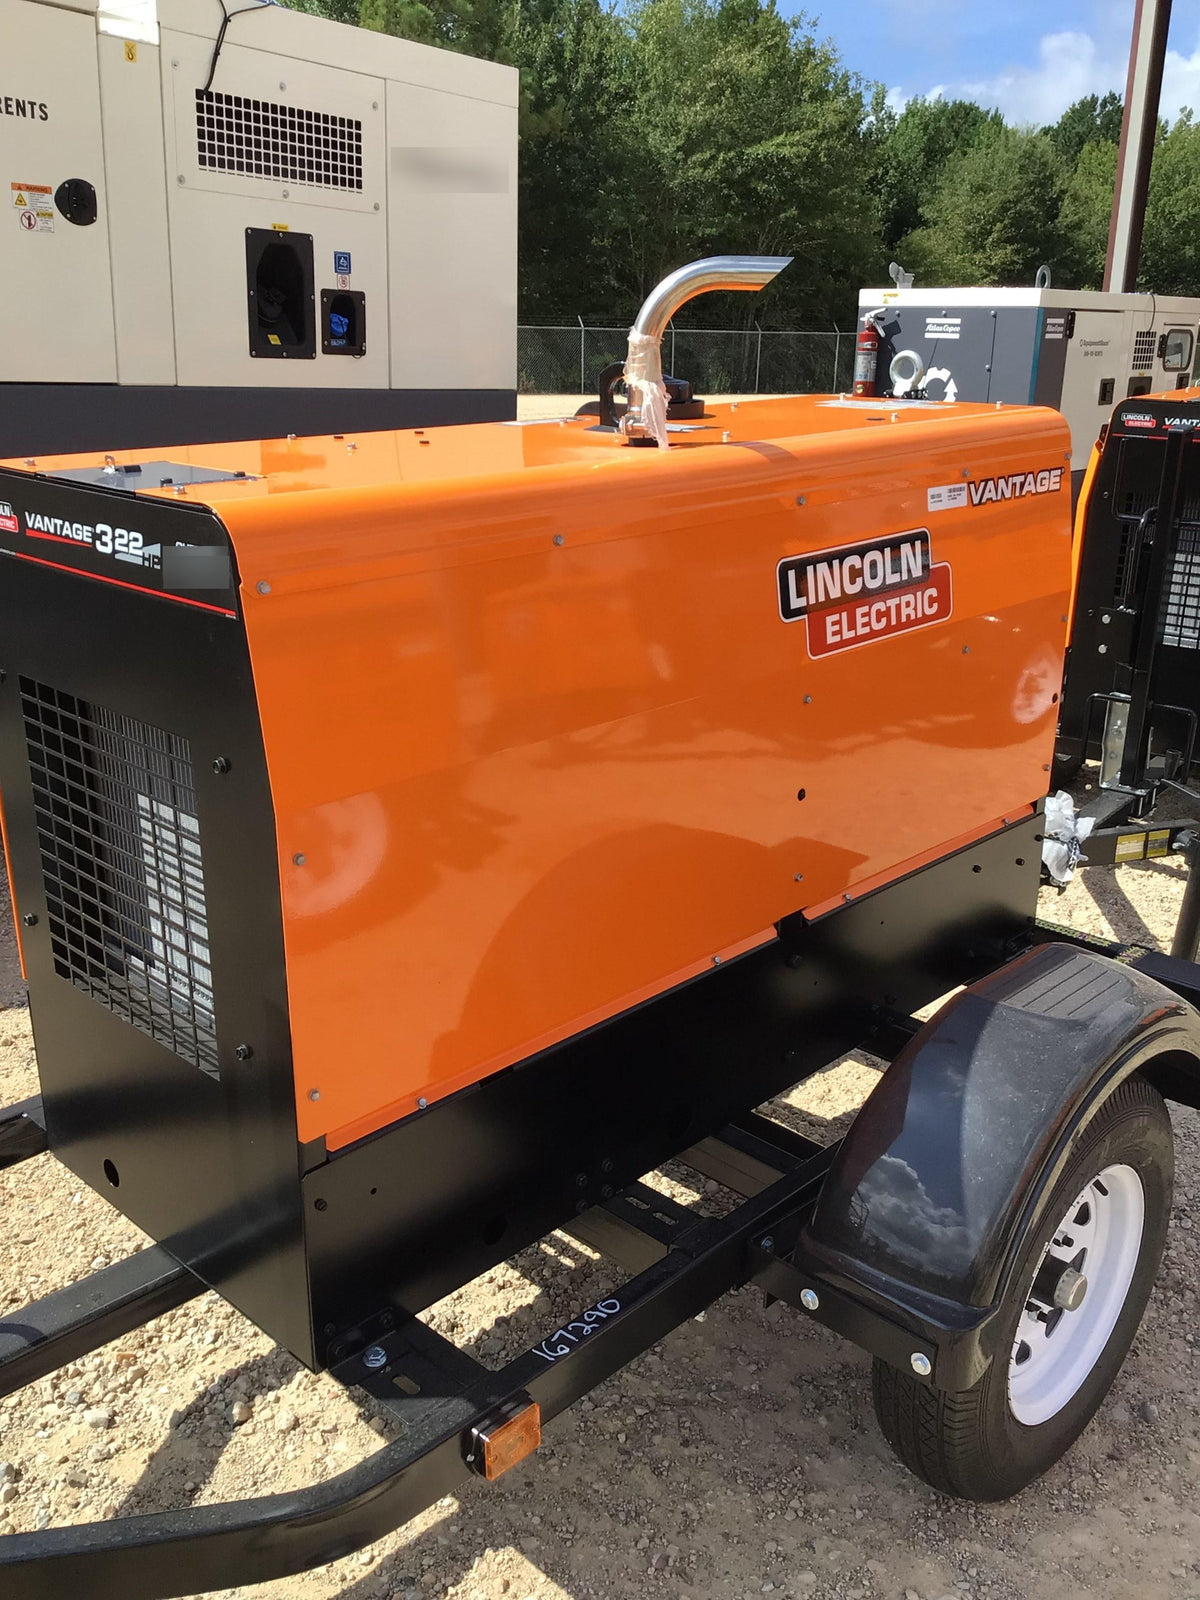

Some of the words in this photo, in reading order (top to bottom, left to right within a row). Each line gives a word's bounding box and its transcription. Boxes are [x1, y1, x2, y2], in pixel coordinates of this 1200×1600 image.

[968, 468, 1062, 506] VANTAGE
[24, 511, 93, 543] VANTAGE
[95, 523, 144, 556] 322
[787, 540, 922, 610] LINCOLN
[825, 587, 939, 645] ELECTRIC
[531, 1298, 621, 1362] 167290
